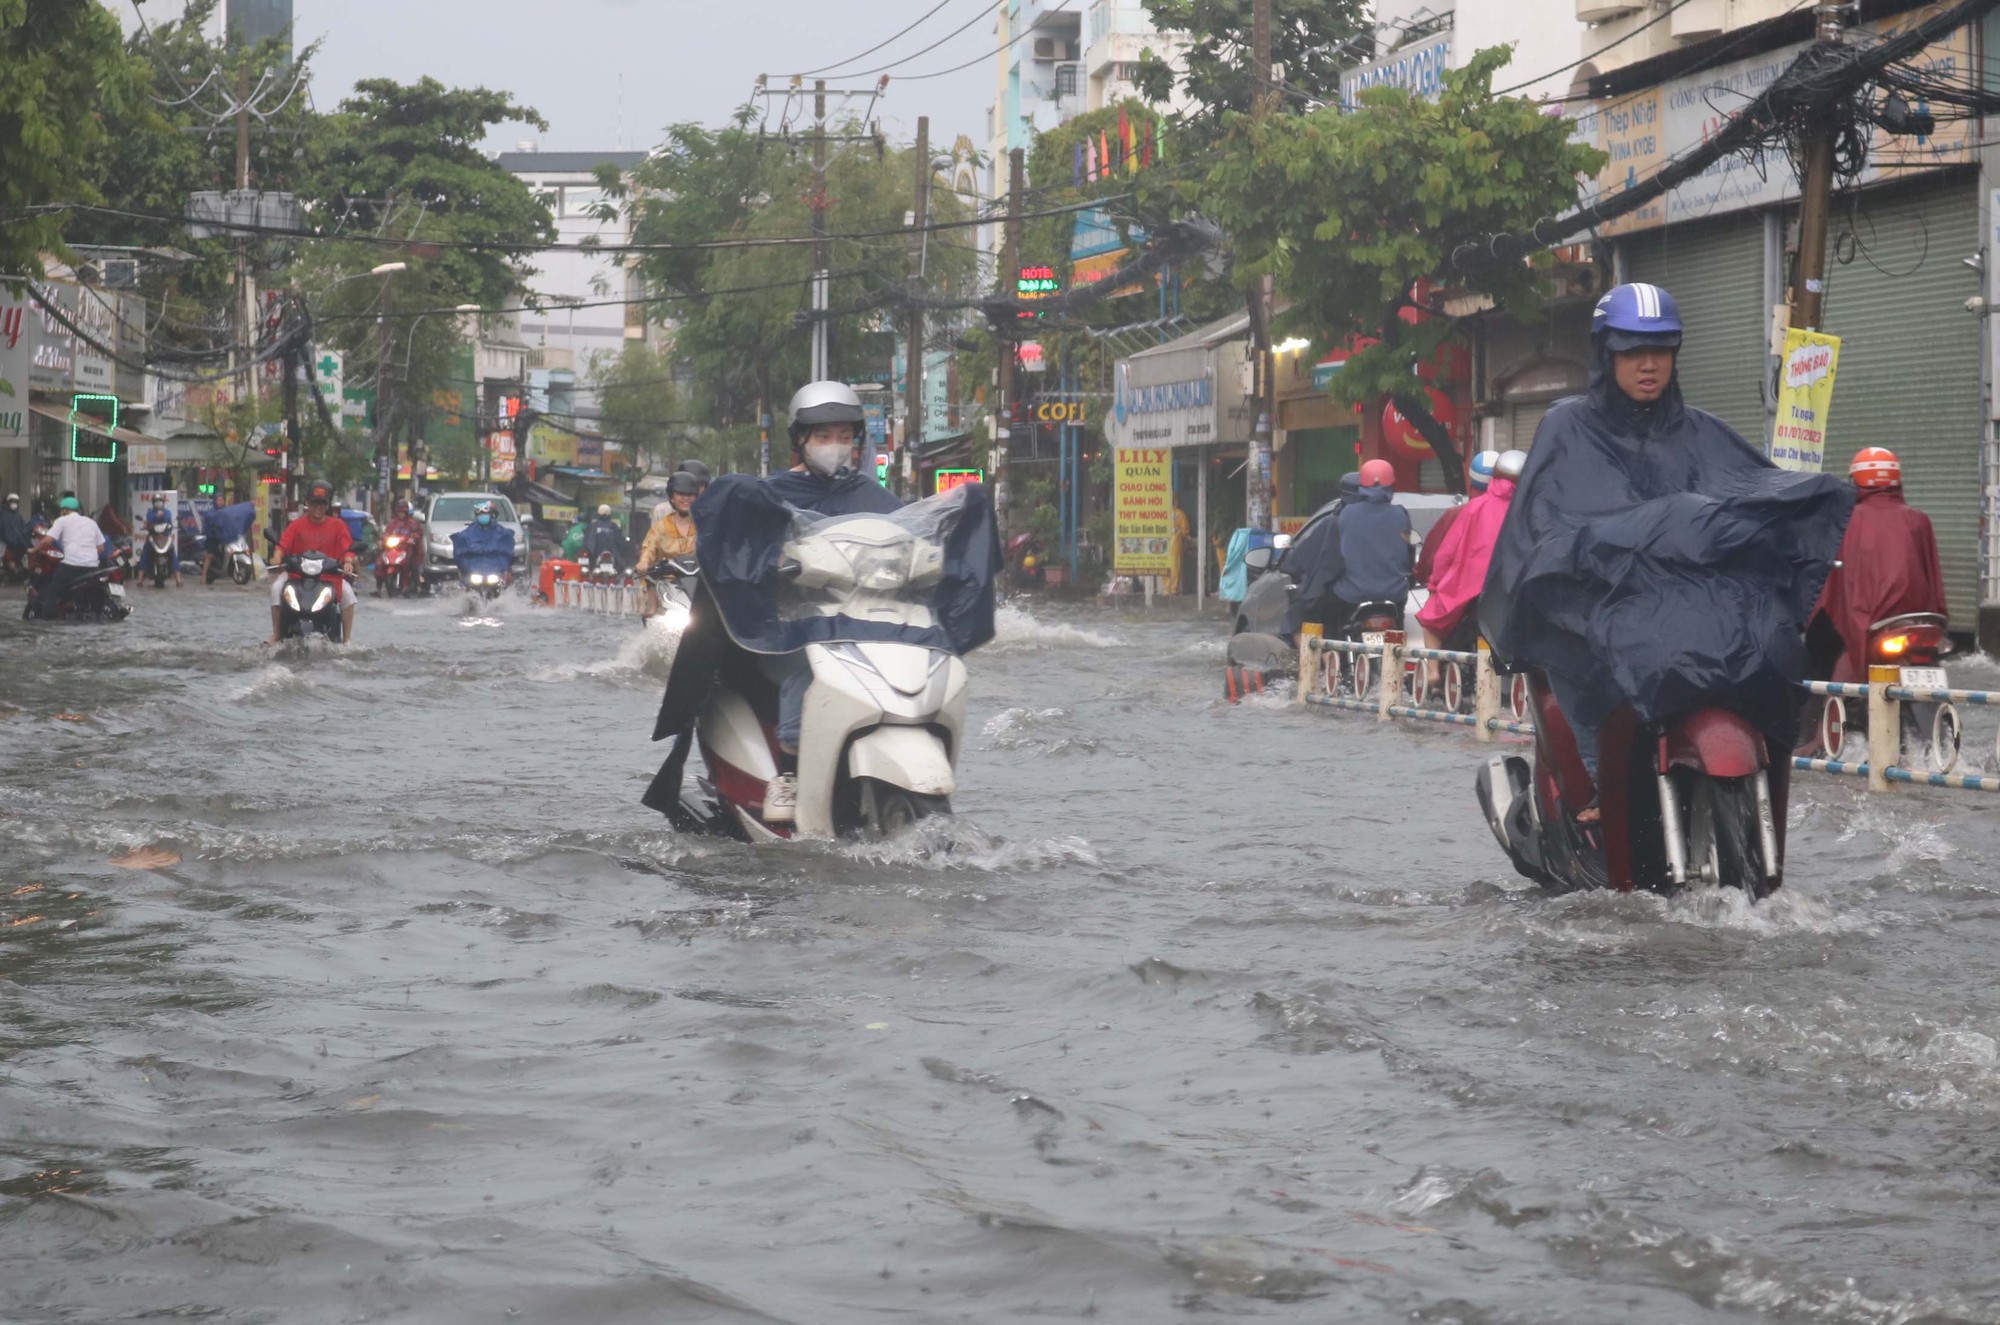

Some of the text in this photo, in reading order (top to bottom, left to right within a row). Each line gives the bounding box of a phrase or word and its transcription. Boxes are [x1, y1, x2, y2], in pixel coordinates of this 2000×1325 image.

[1604, 106, 1629, 136] Thép
[1632, 99, 1657, 130] Nhật
[1633, 136, 1656, 157] KYOEI
[1119, 450, 1167, 463] LILY
[1126, 466, 1160, 476] QUÁN
